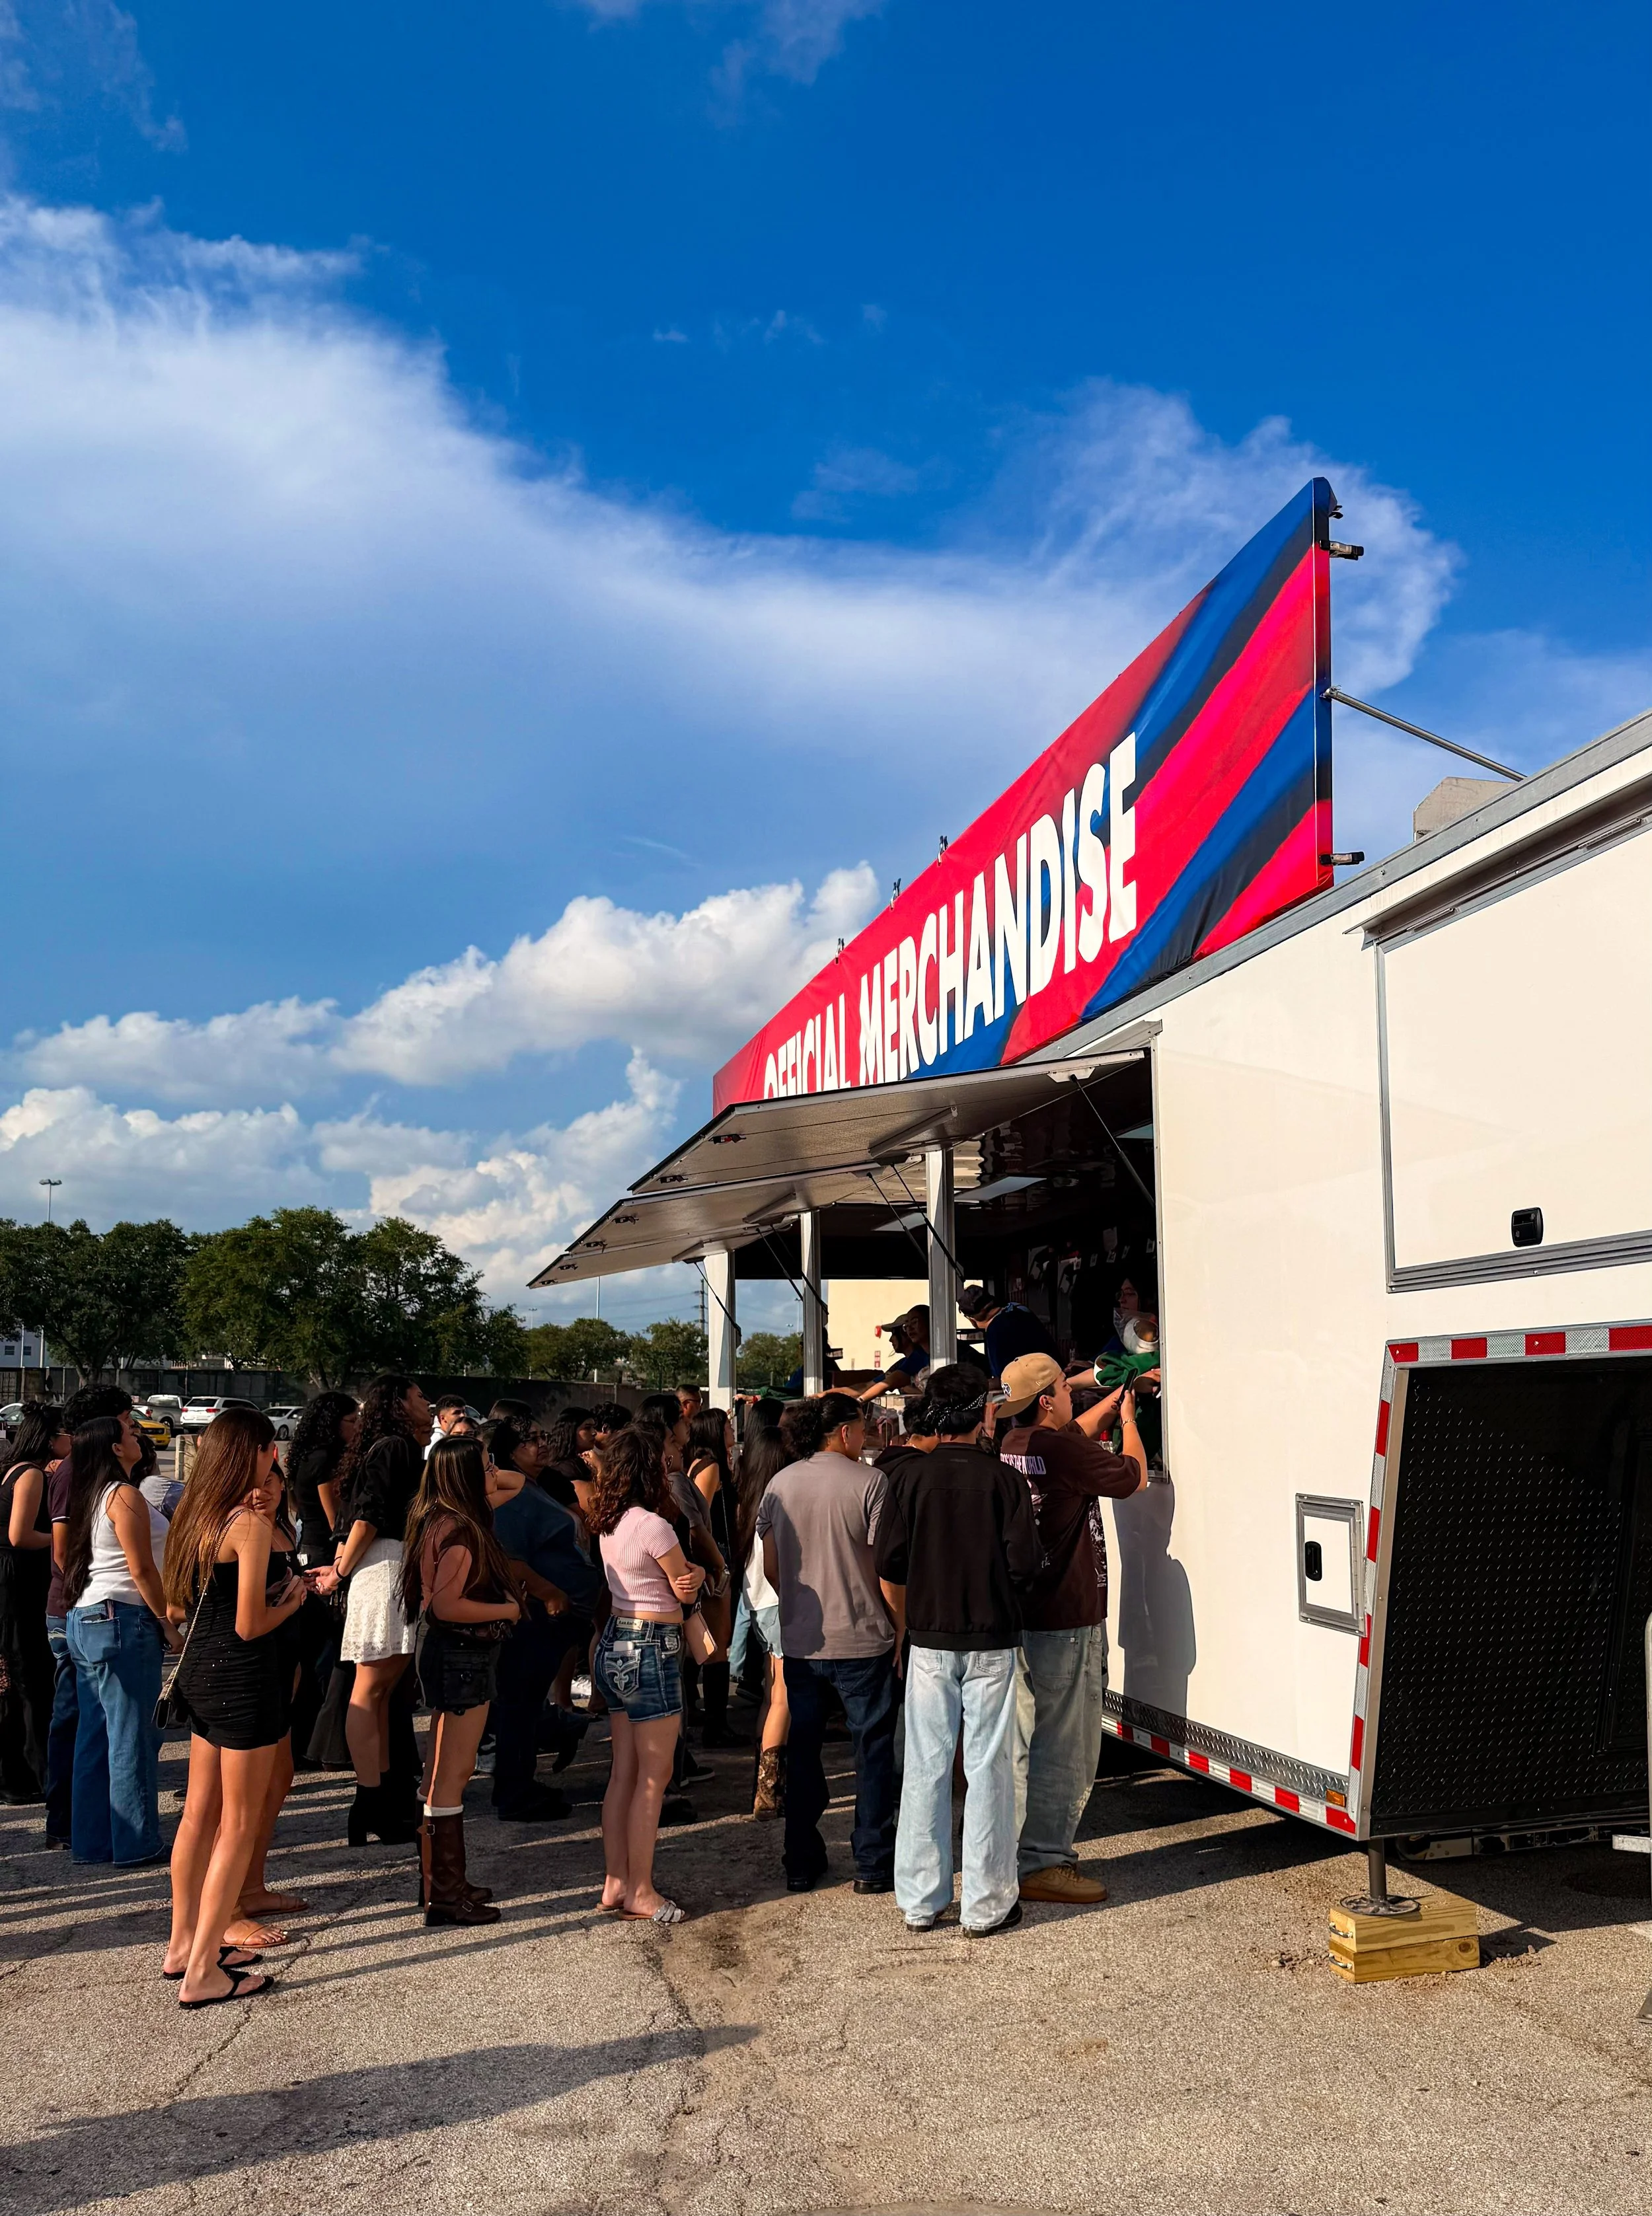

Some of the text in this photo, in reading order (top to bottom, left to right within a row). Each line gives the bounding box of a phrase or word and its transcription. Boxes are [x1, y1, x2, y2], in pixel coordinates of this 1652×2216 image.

[764, 731, 1137, 1099] OFFICIAL MERCHANDISE
[1022, 1456, 1046, 1474] WORLD
